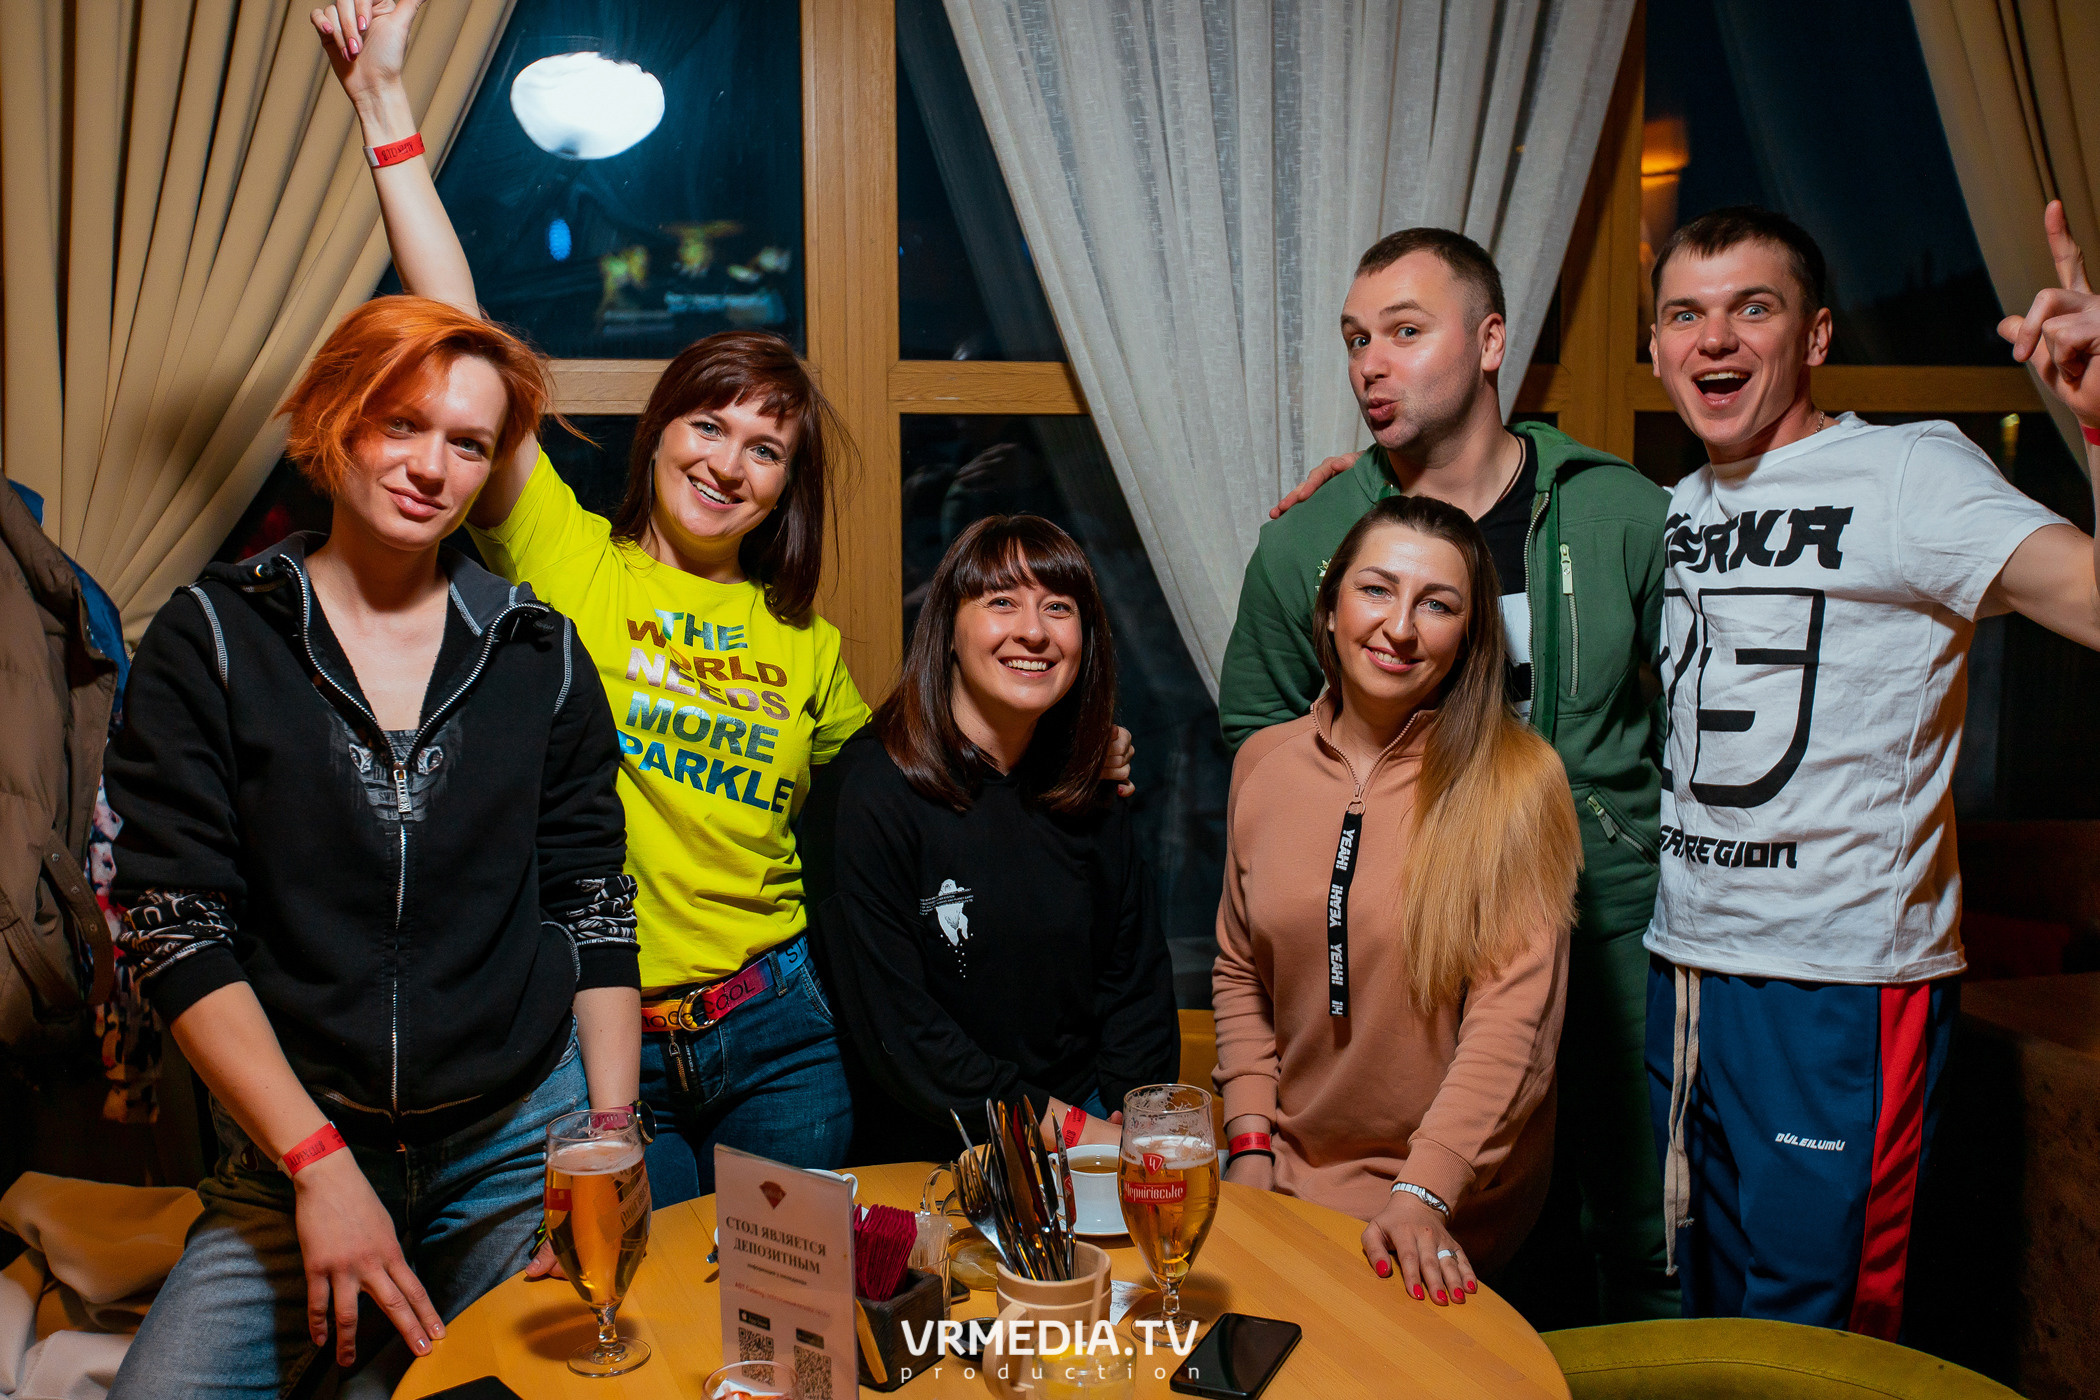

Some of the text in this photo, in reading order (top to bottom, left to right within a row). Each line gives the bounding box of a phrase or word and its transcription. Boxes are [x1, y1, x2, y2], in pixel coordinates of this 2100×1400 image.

[654, 608, 748, 651] THE
[626, 618, 788, 688] WORLD
[625, 647, 790, 721] NEEDS
[625, 691, 779, 764] MORE
[1335, 828, 1356, 871] YEAH!
[1329, 884, 1344, 928] YEAH!
[1330, 943, 1344, 986] YEAH!
[726, 1216, 826, 1257] СТОЛ ЯВЛЯЕТСЯ
[733, 1237, 820, 1274] ДЕПОЗИТНЫМ
